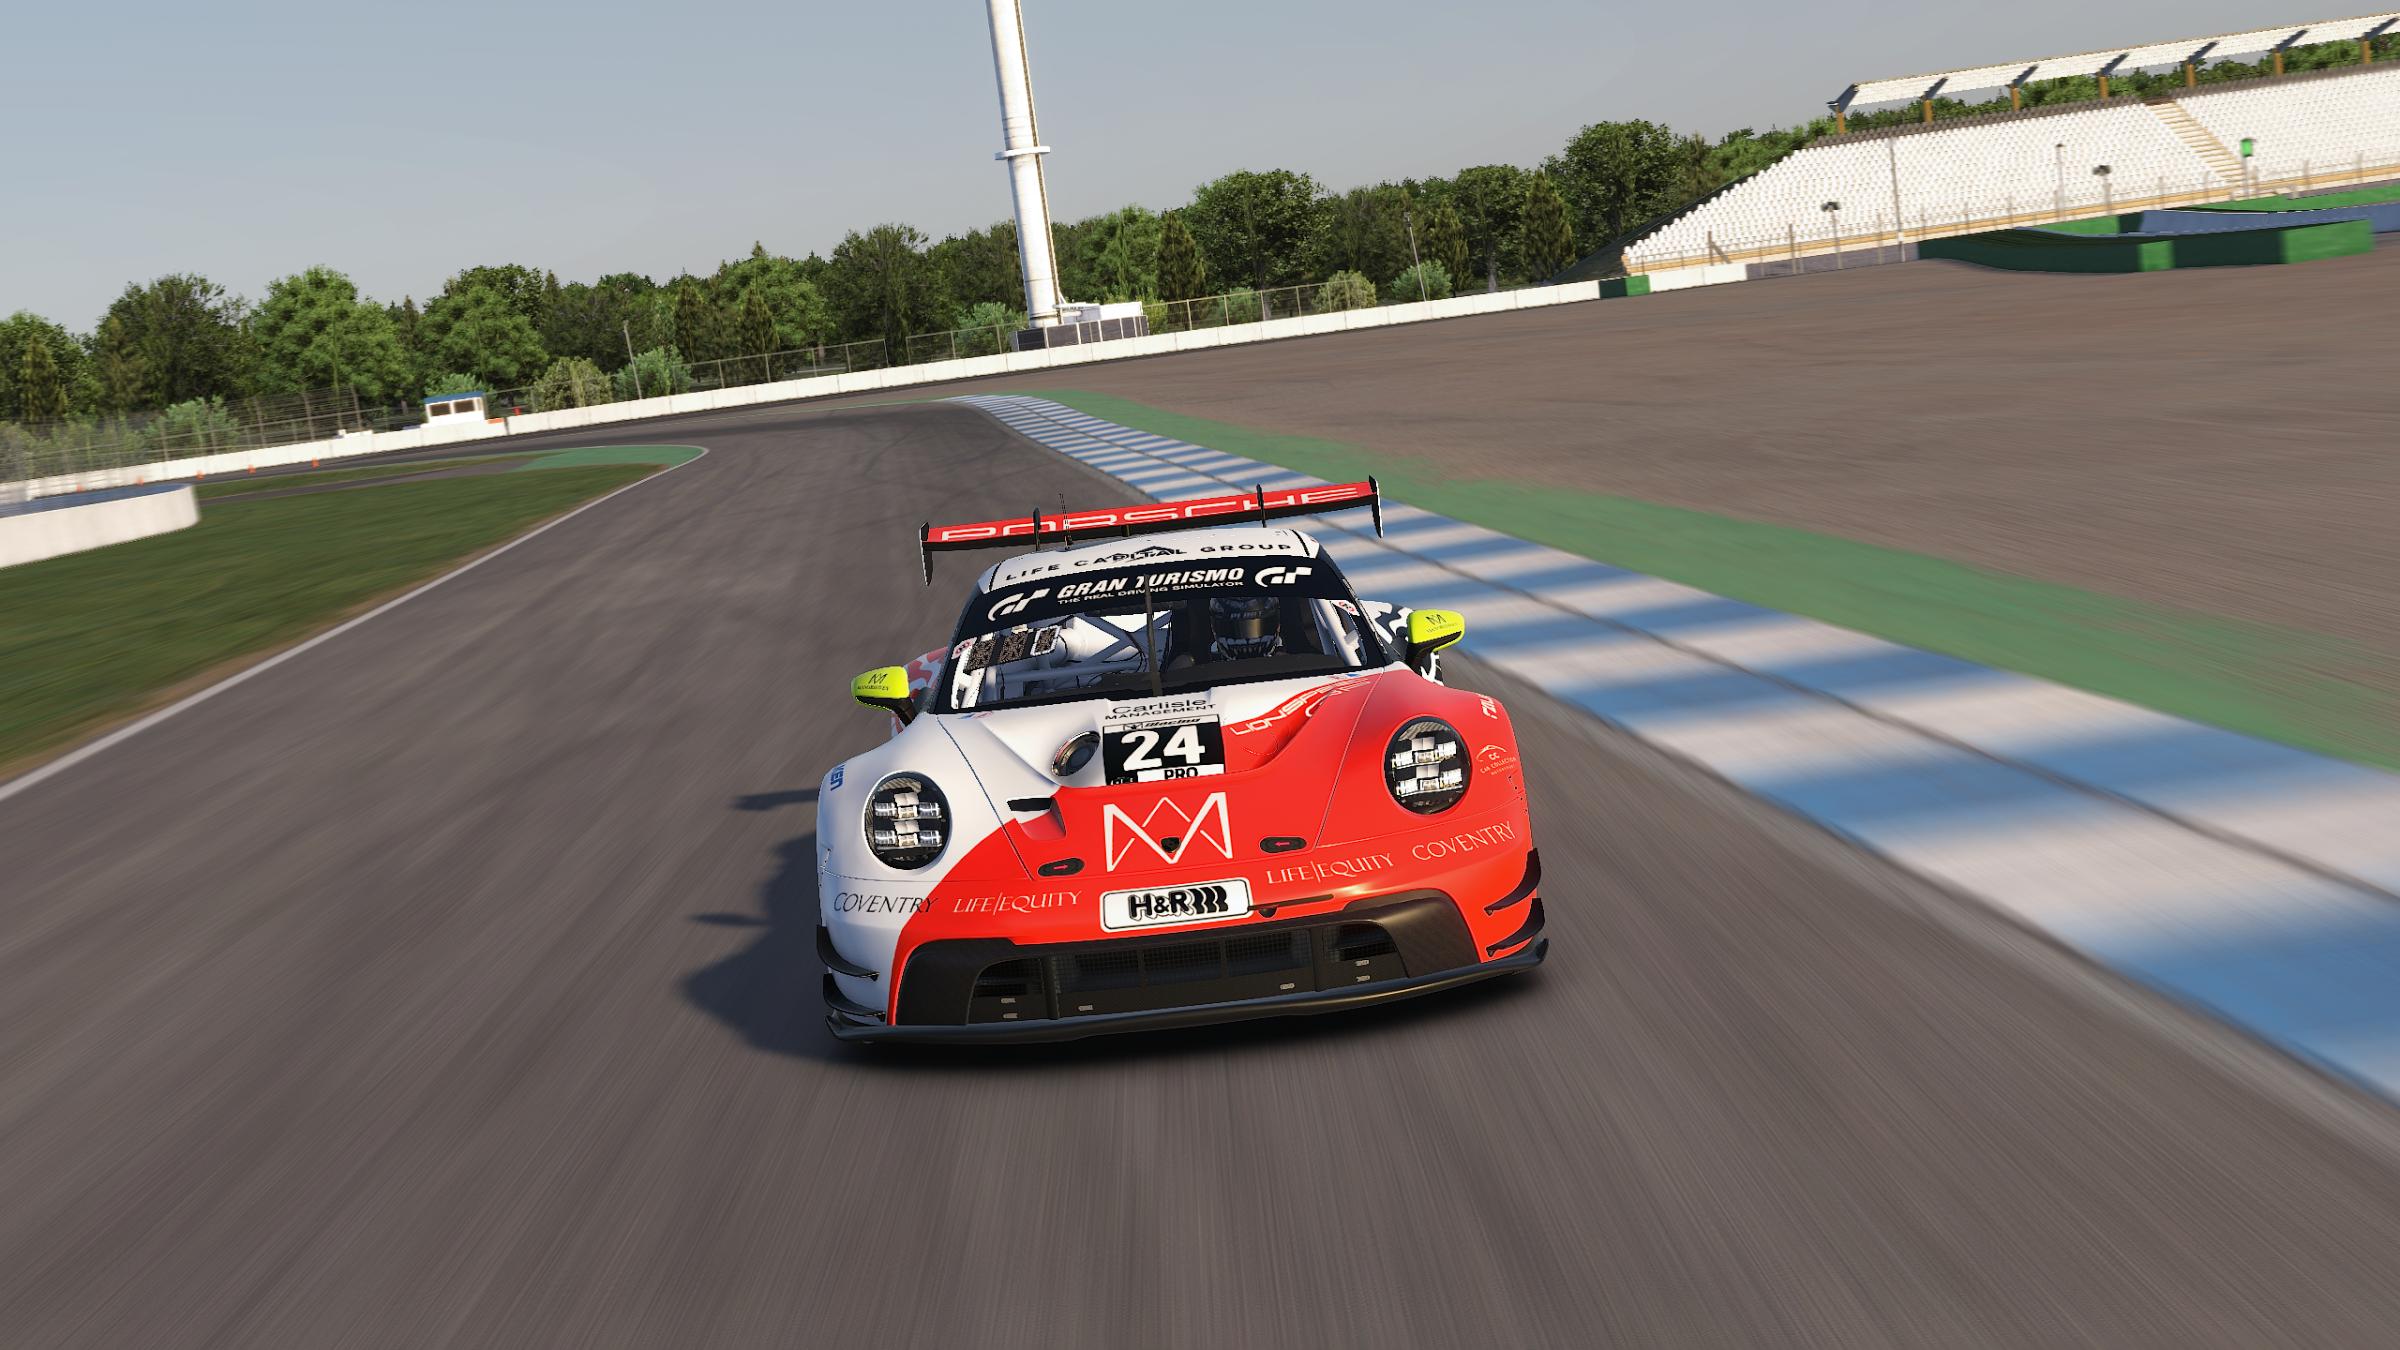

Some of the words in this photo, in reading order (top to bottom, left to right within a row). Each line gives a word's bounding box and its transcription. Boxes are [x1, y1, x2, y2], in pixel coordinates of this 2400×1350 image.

[942, 487, 1359, 541] PORSCHE
[1006, 564, 1060, 581] LIFE
[1200, 544, 1291, 553] GROUP
[1056, 576, 1129, 599] GRAN
[1057, 597, 1081, 605] THE
[1083, 592, 1114, 601] REAL
[1117, 586, 1168, 598] DRIVNG
[1172, 580, 1244, 591] SIMULATOR
[1105, 703, 1217, 720] MANAGEMENT
[1112, 699, 1207, 714] Carlisle
[1121, 725, 1206, 771] 24
[1163, 766, 1198, 780] PRO
[1412, 820, 1516, 861] COVENTRY
[833, 892, 938, 914] COVENTRY
[1128, 889, 1195, 921] H&R
